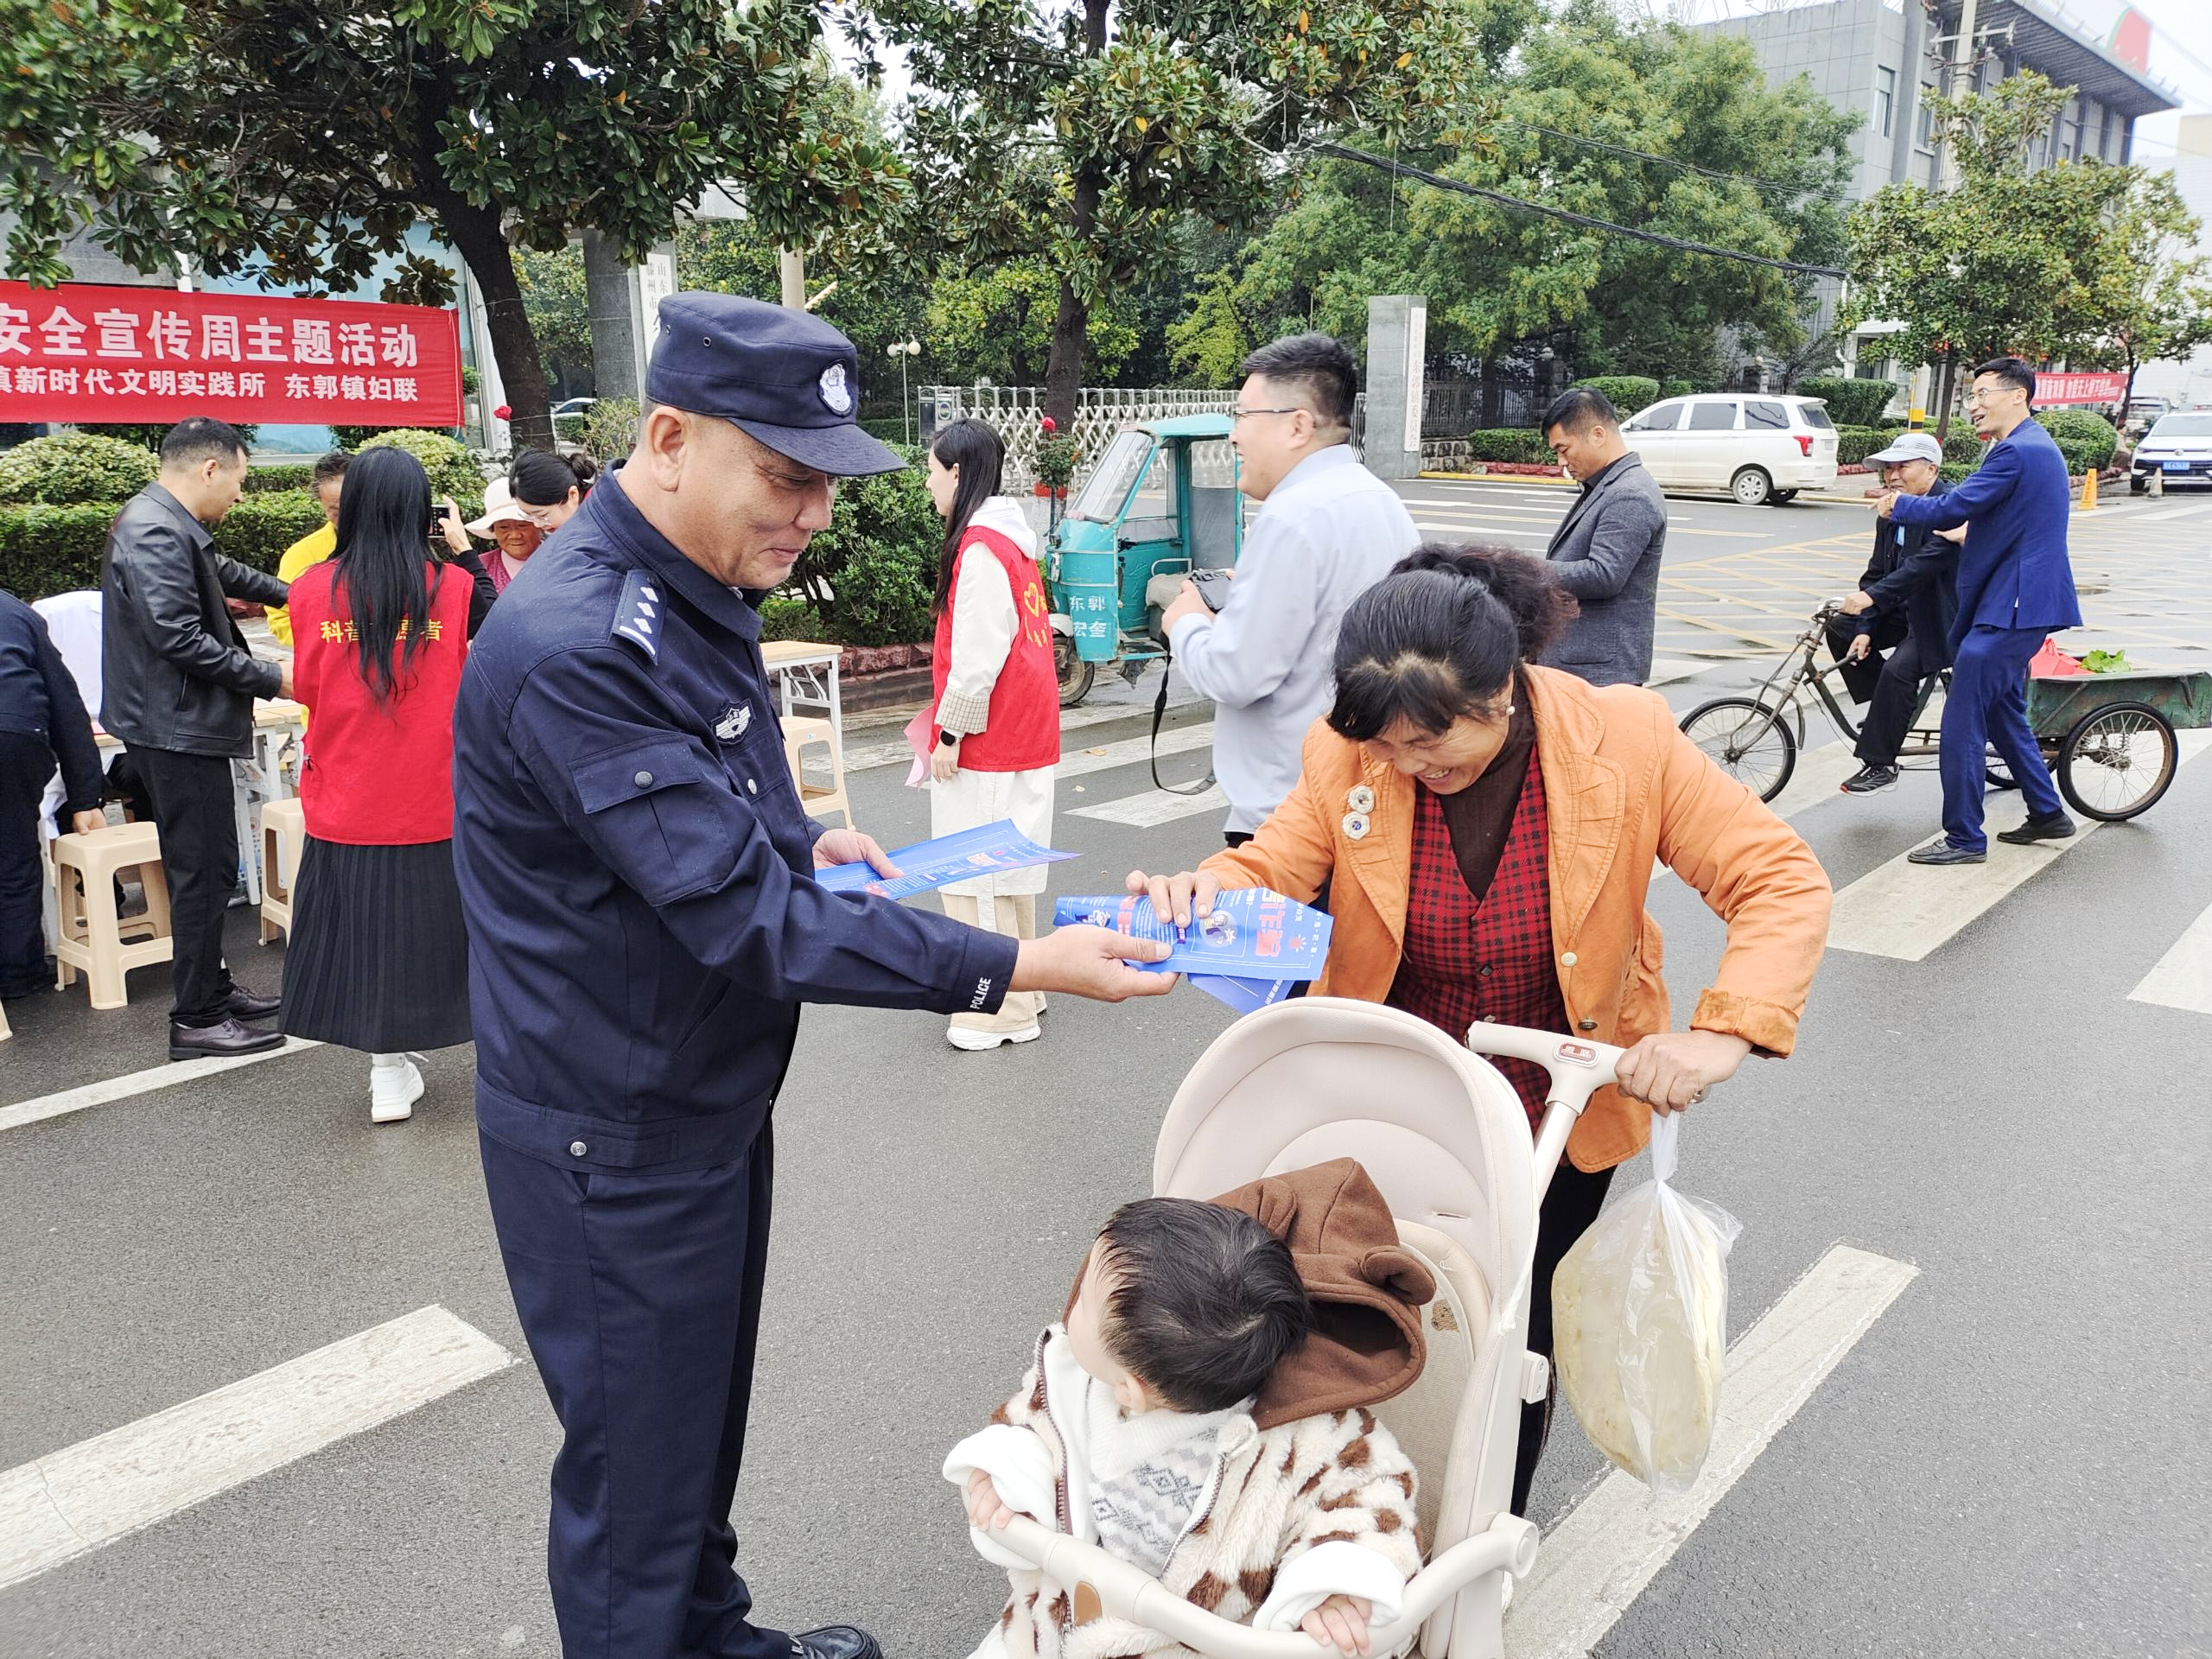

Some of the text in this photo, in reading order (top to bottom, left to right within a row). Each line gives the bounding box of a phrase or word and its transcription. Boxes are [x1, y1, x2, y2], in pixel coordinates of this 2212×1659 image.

[0, 302, 418, 367] 安全宣传周主题活动
[284, 373, 418, 402] 东郭镇妇联
[1070, 595, 1106, 611] 东郭
[321, 619, 443, 643] 科普愿者
[969, 977, 992, 1009] POLICE
